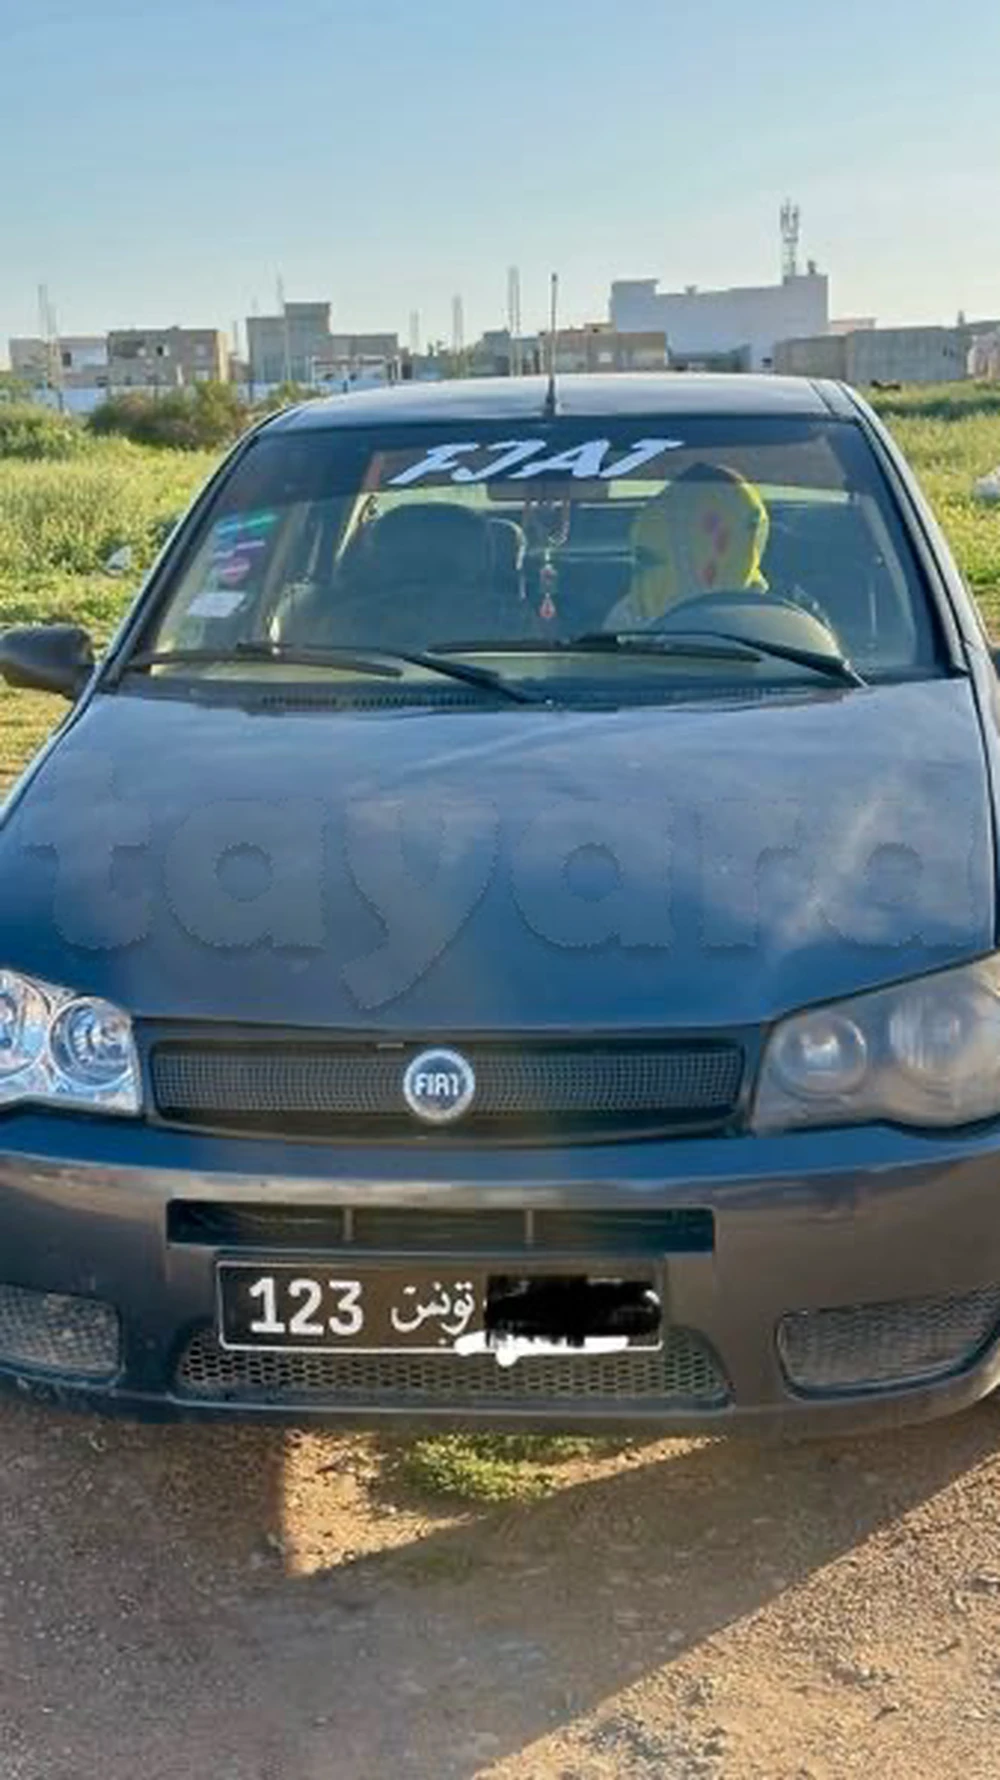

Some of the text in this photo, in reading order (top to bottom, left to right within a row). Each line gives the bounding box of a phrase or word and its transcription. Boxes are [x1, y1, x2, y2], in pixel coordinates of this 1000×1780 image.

[415, 1072, 459, 1097] FIAT
[248, 1276, 476, 1337] 123 تونس
